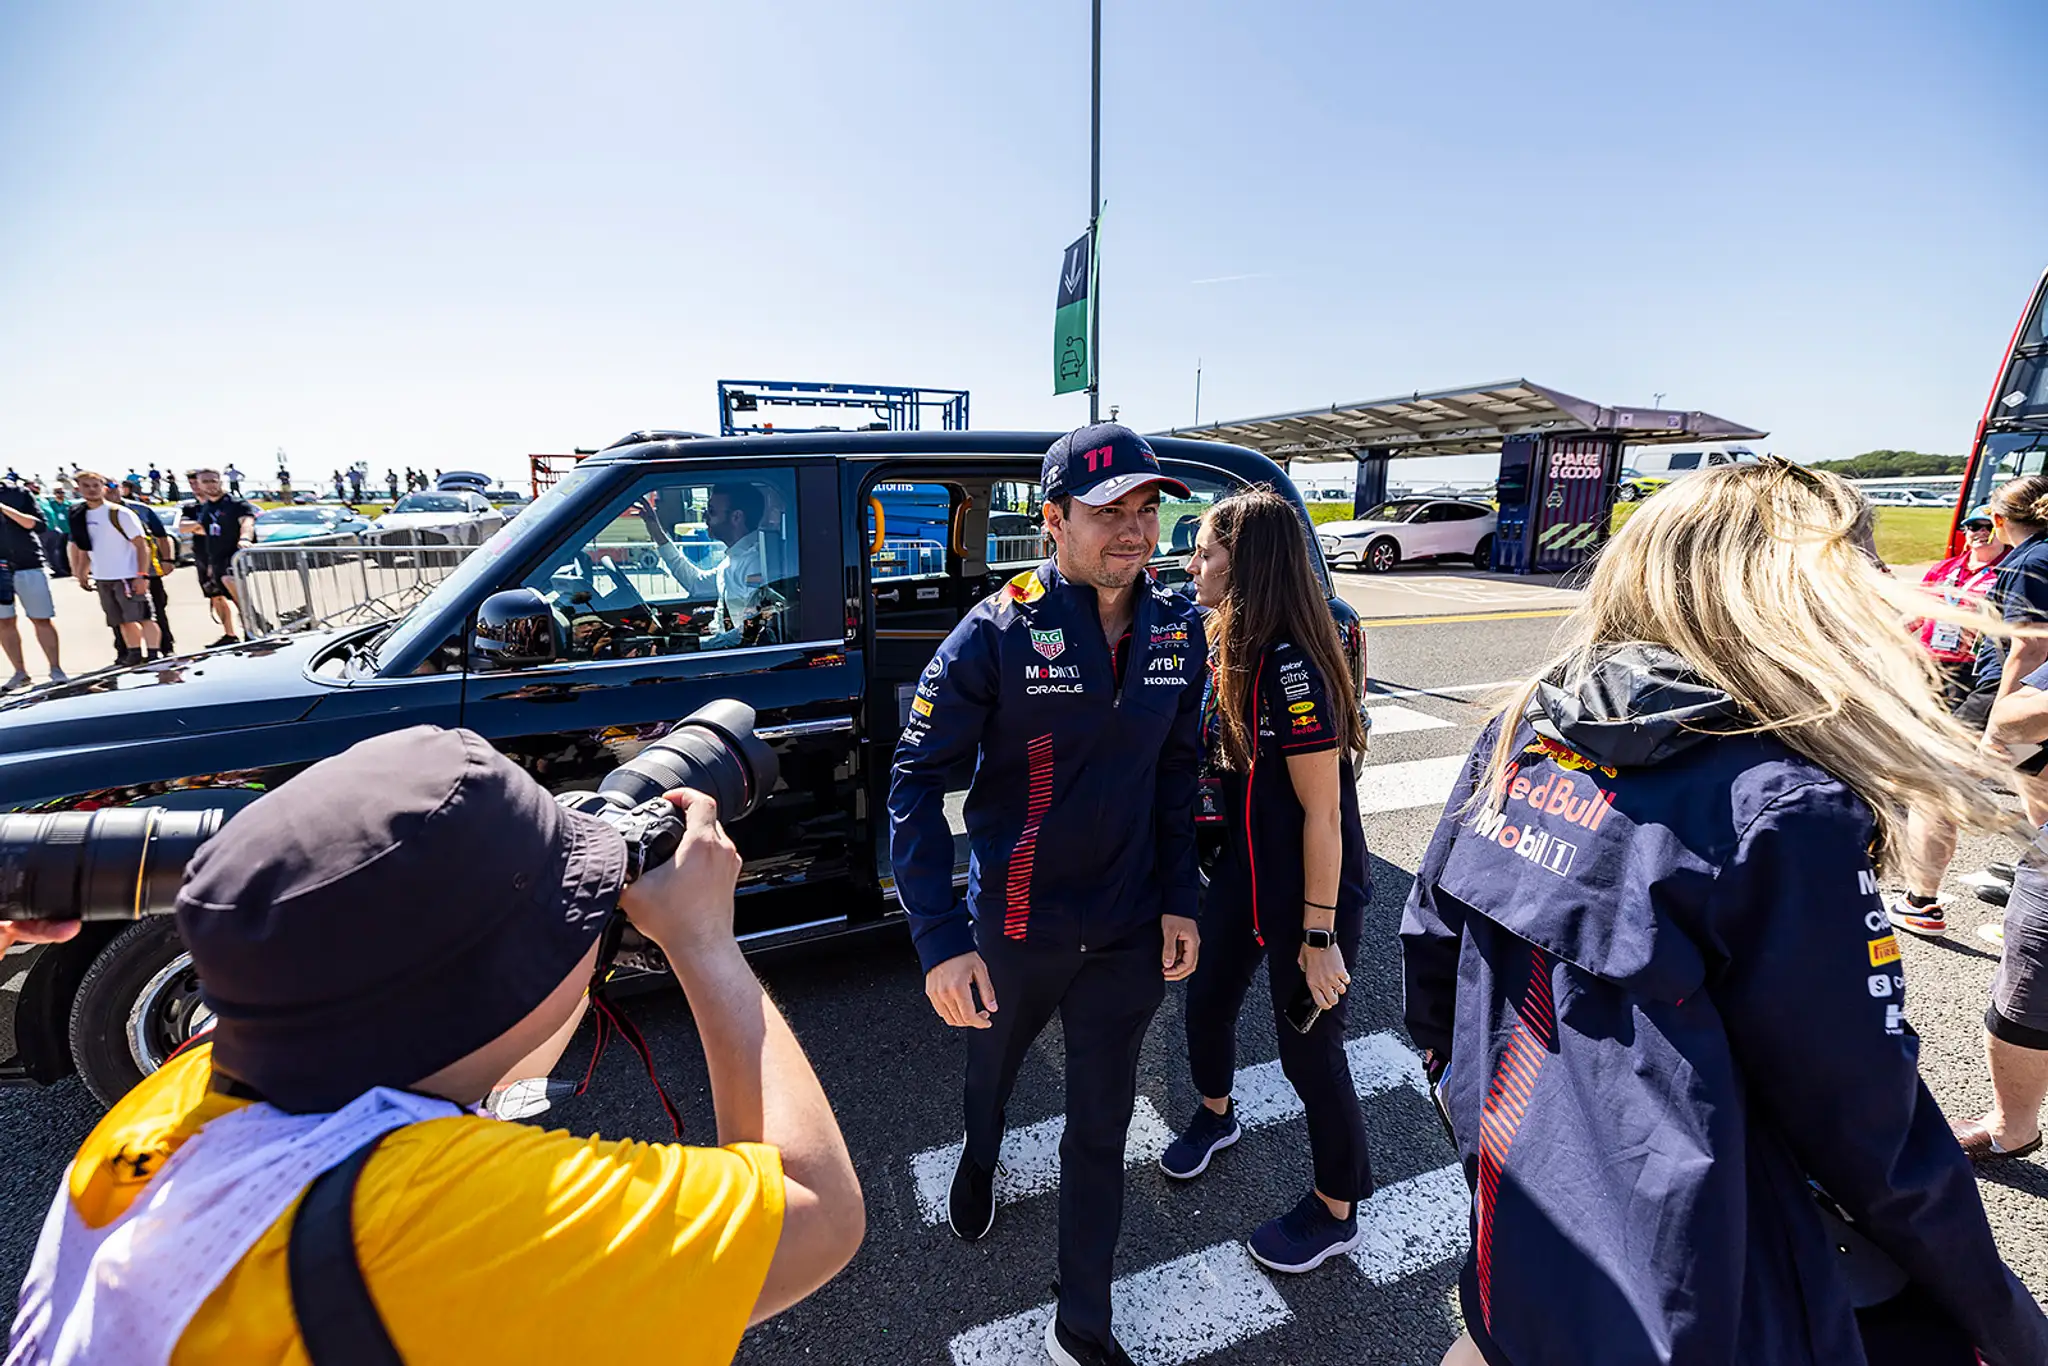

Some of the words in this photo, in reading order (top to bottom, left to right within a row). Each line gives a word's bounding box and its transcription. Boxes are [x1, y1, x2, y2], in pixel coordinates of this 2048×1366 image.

[1083, 445, 1113, 472] 11
[1551, 452, 1599, 466] CHARGE
[1033, 632, 1060, 642] TAG
[1143, 677, 1188, 685] HONDA
[1280, 669, 1309, 685] citrix
[1026, 683, 1084, 695] ORACLE
[1474, 806, 1549, 864] Mobil
